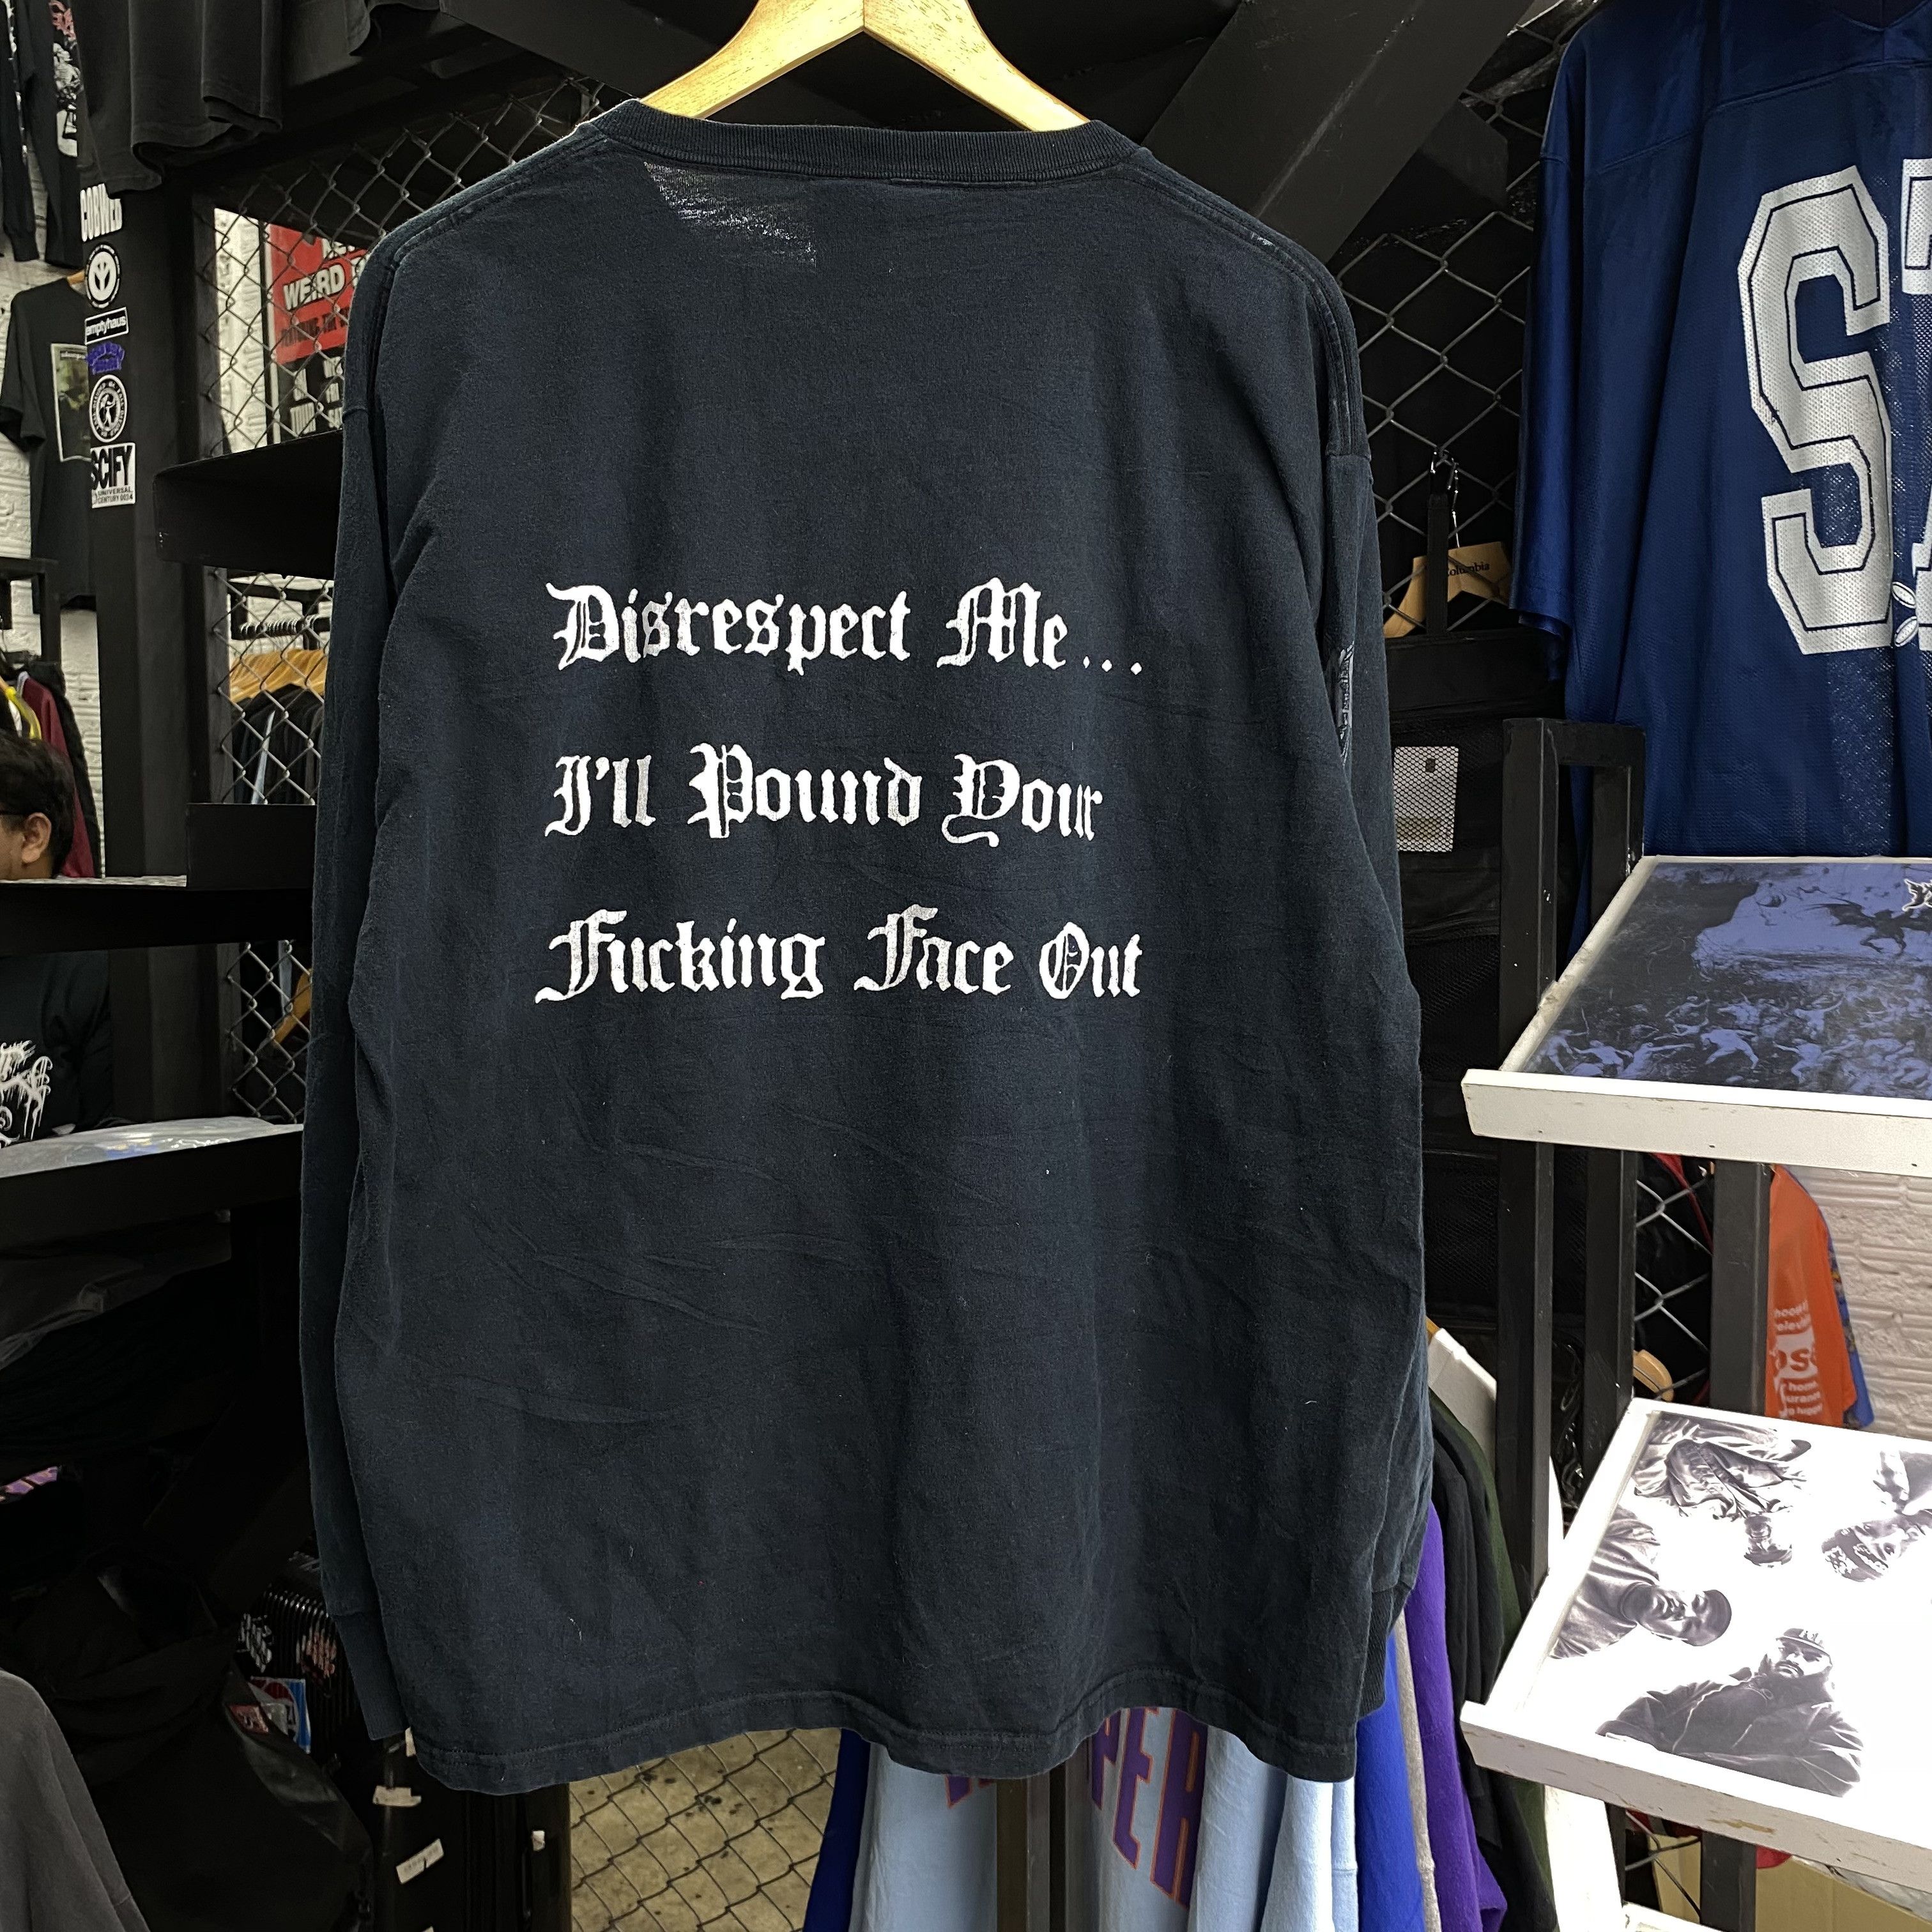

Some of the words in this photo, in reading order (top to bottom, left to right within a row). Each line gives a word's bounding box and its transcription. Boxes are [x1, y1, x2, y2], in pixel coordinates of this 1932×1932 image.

[544, 581, 912, 677] Disrespect
[544, 754, 657, 838] I'll
[686, 742, 923, 839] Pound
[940, 753, 1103, 848] Your
[534, 908, 827, 1004] Fucking
[852, 903, 1015, 997] Face
[1038, 921, 1144, 1000] Out
